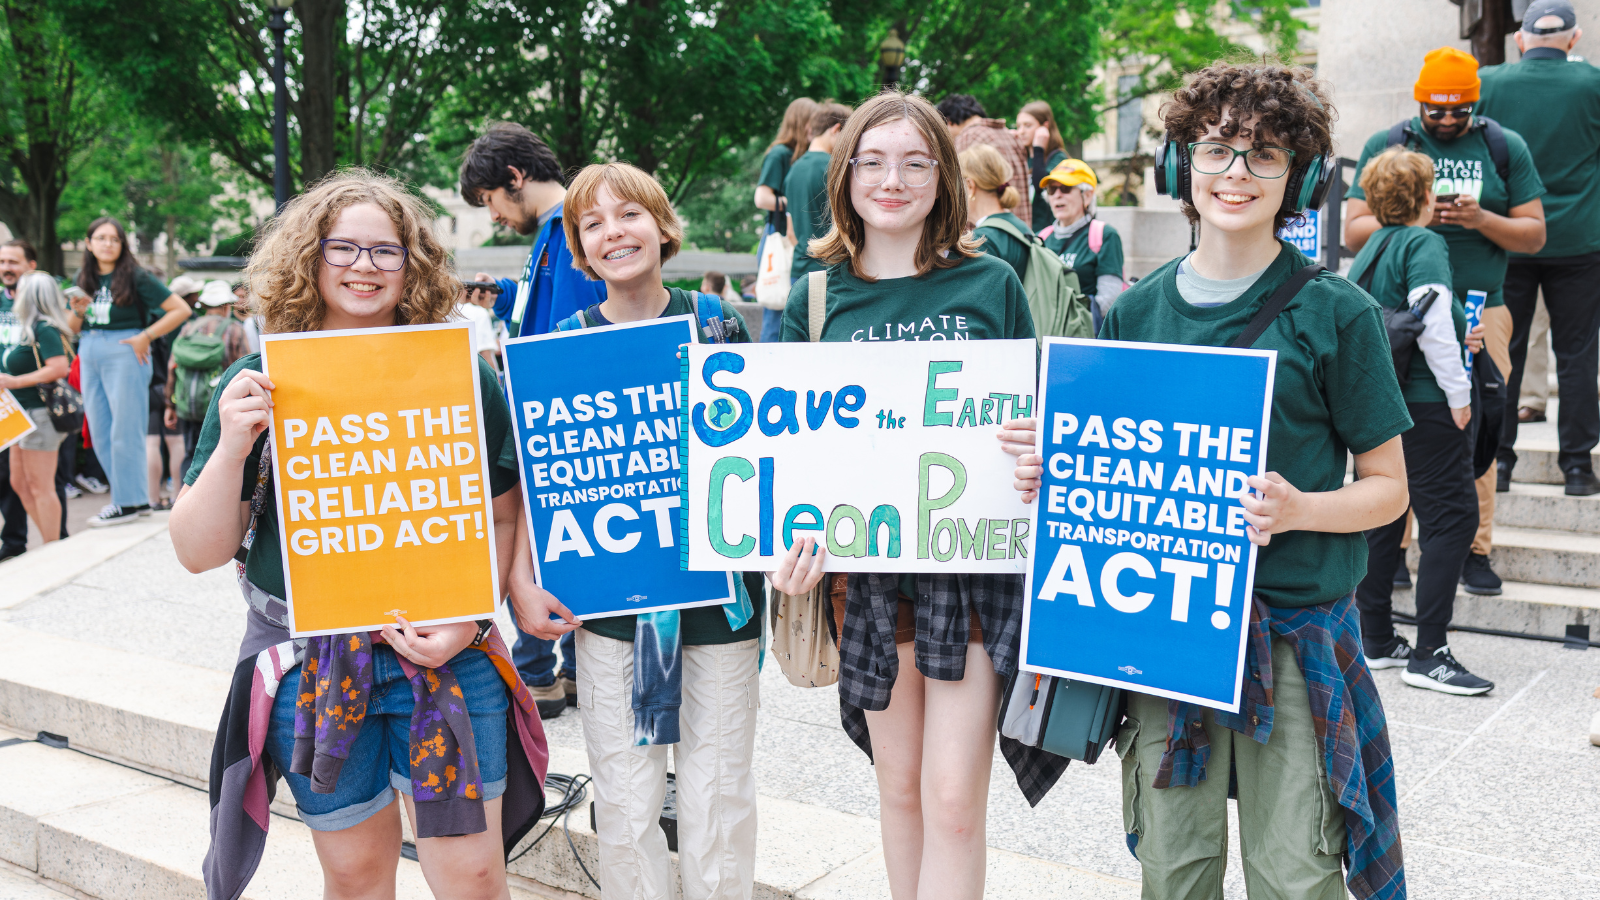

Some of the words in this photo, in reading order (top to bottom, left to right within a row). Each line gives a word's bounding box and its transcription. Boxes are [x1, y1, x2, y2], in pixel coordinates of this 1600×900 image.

[1432, 178, 1483, 203] OW
[1433, 168, 1483, 179] CTION
[851, 315, 968, 342] CLIMATE
[522, 390, 618, 429] PASS
[692, 351, 866, 448] Save
[876, 409, 906, 429] the
[284, 412, 389, 448] PASS
[398, 404, 471, 438] THE
[527, 424, 625, 458] CLEAN
[633, 416, 681, 446] AN
[1052, 412, 1164, 453] PASS
[1173, 422, 1254, 463] THE
[286, 448, 397, 480] CLEAN
[405, 441, 475, 471] AND
[532, 445, 681, 488] EQUITABL
[1048, 452, 1164, 490] CLEAN
[1170, 464, 1250, 499] AND
[288, 473, 481, 522] RELIABLE
[707, 456, 901, 558] Clean
[1047, 485, 1246, 537] EQUITABLE
[290, 523, 384, 556] GRID
[394, 511, 484, 548] ACT!
[1046, 520, 1241, 563] TRANSPORTATION
[1037, 543, 1236, 630] ACT!
